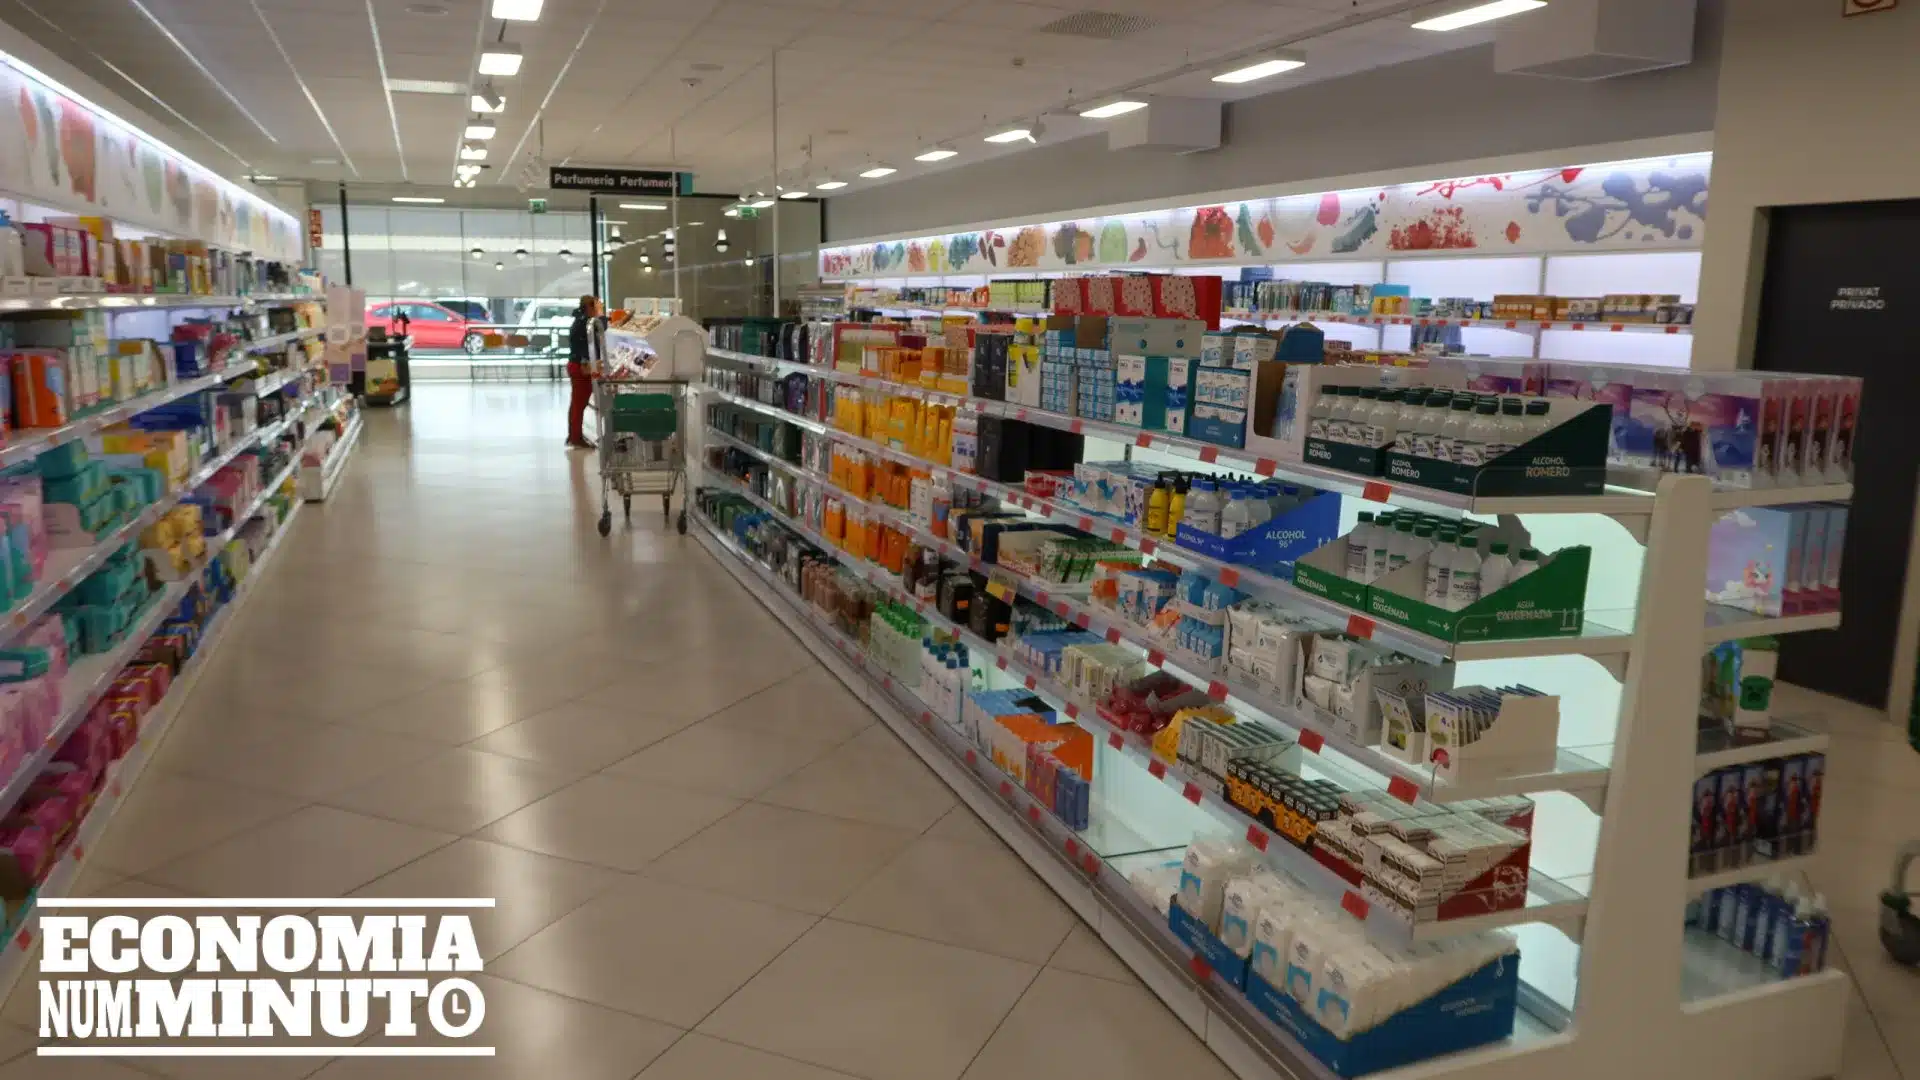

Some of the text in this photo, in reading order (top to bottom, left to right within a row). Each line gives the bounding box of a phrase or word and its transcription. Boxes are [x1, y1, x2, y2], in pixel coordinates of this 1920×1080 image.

[1837, 287, 1880, 297] PRIVAT
[1830, 299, 1885, 310] PRIVADO
[1308, 449, 1331, 461] ROMERO
[1392, 459, 1412, 469] ALCOHOL
[1532, 456, 1565, 465] ALCOHOL
[1391, 467, 1420, 479] ROMERO
[1526, 466, 1570, 477] ROMERO
[1265, 530, 1306, 540] ALCOHOL
[1517, 600, 1534, 608] AGUA
[1372, 601, 1409, 622] OXIGENADA
